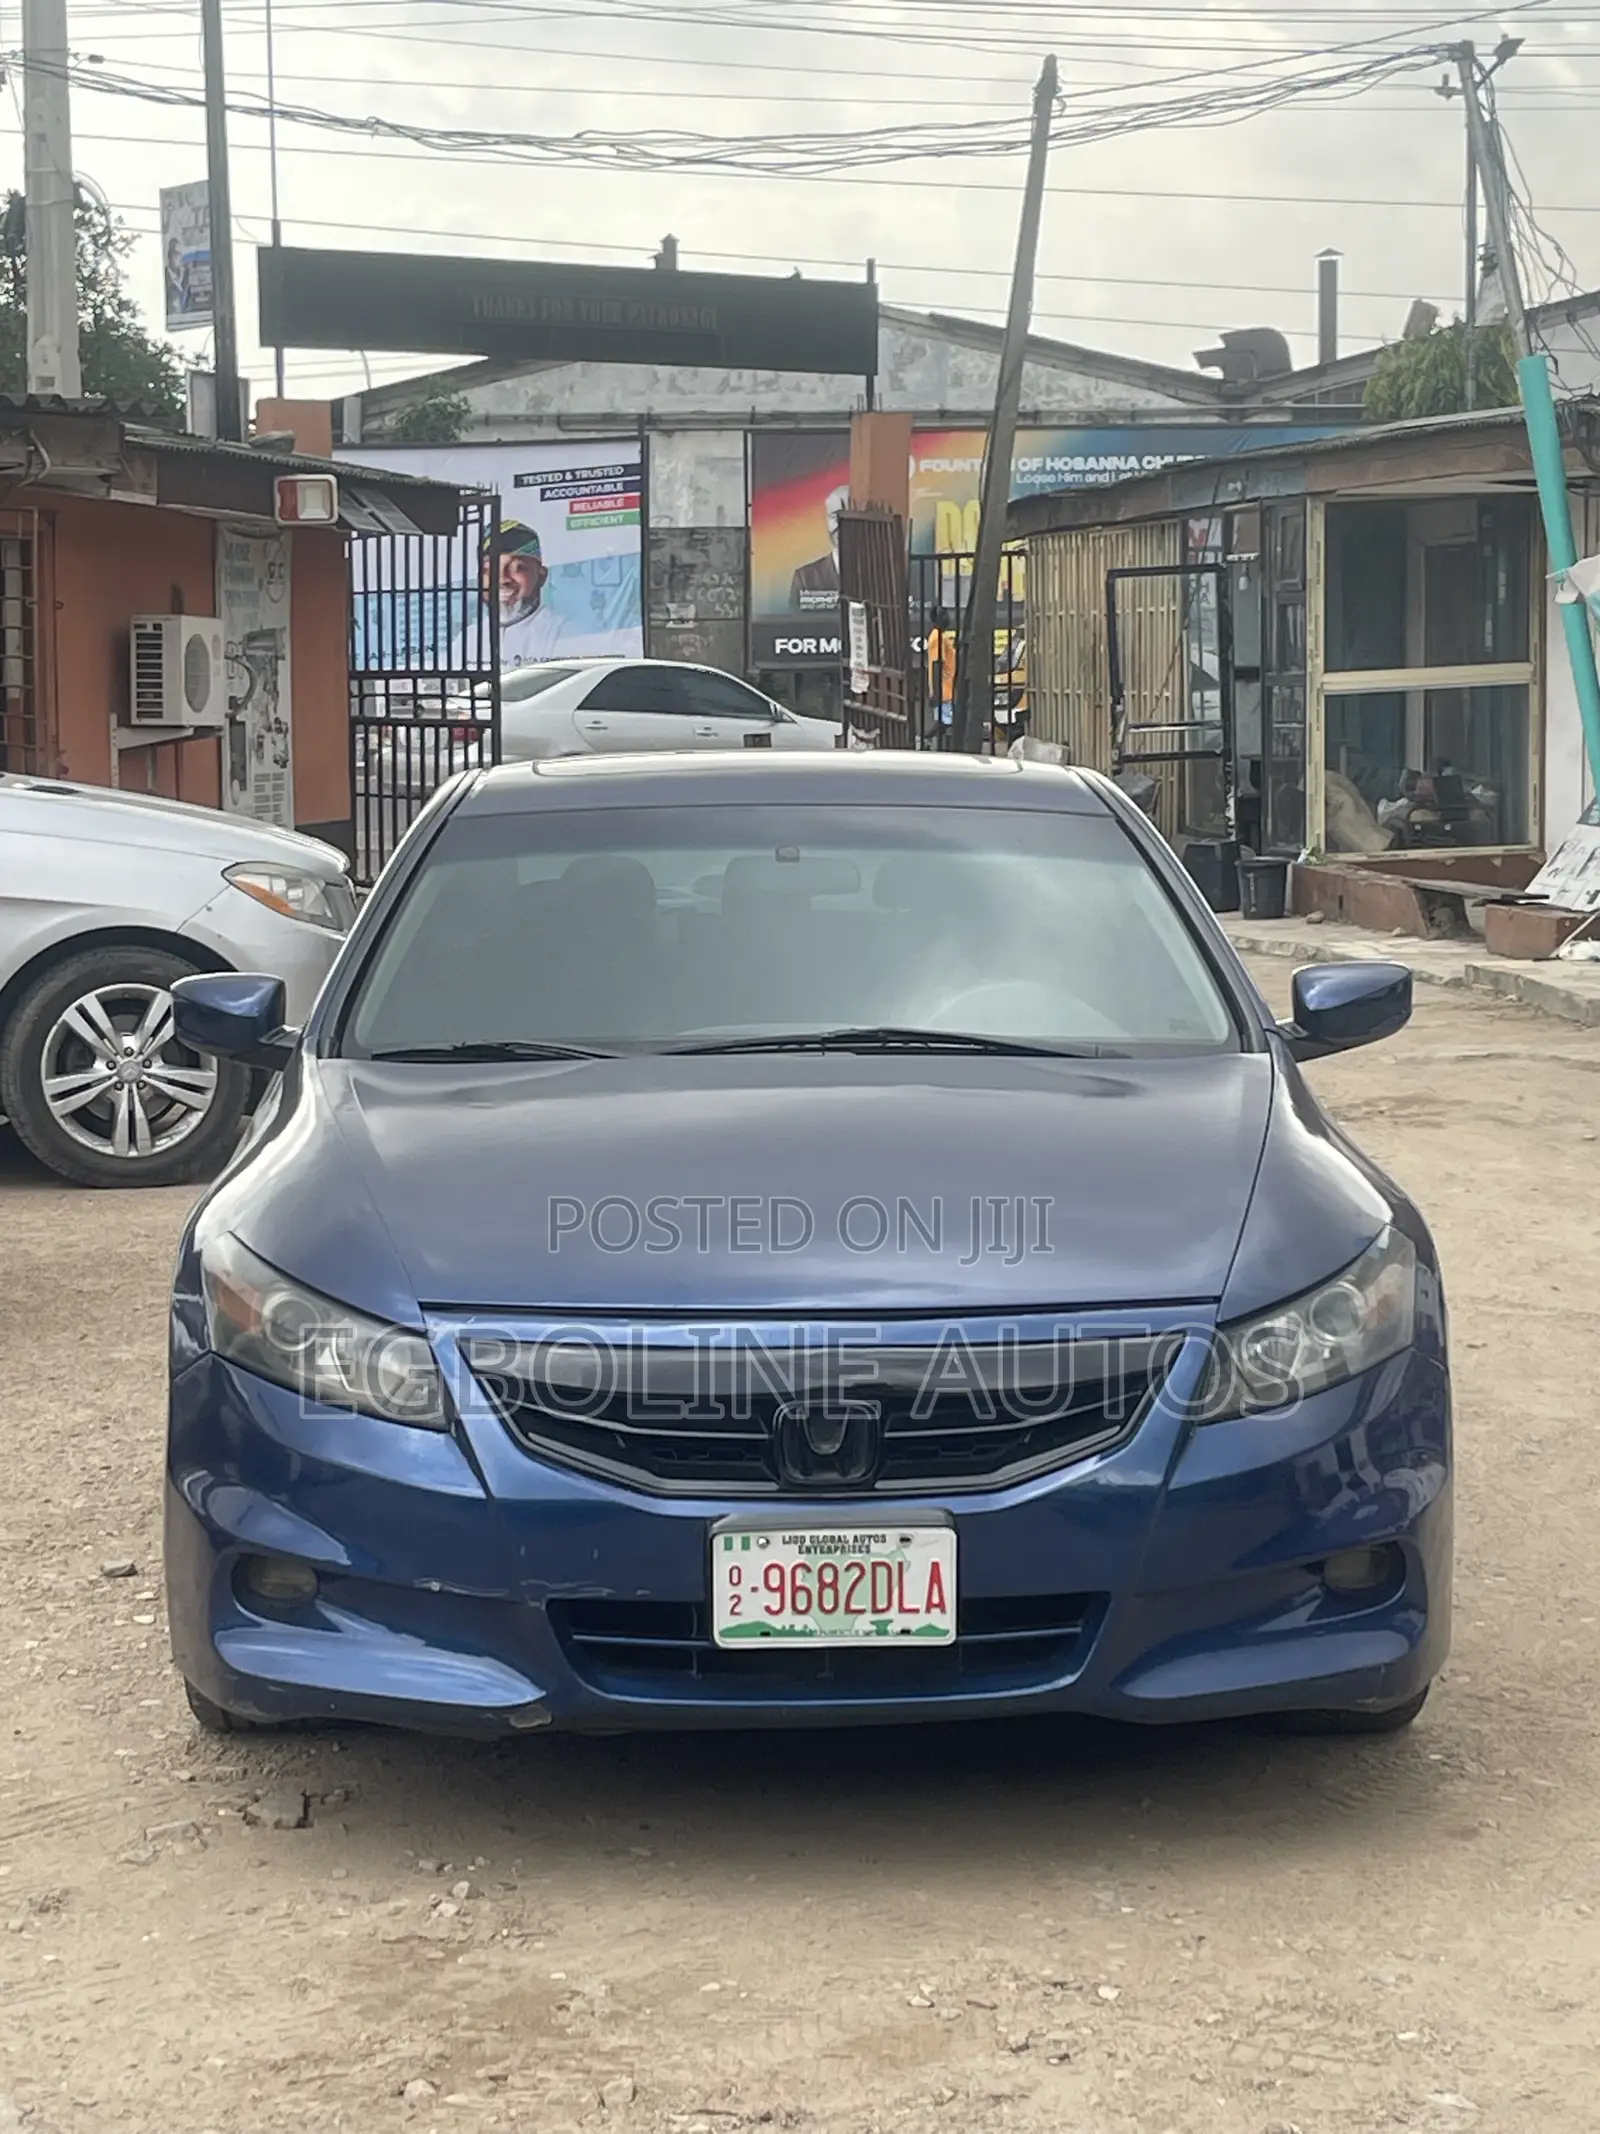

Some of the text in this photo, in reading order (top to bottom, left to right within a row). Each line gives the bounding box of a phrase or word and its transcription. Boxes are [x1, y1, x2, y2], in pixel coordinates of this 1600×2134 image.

[1017, 457, 1043, 472] OF
[1046, 455, 1139, 471] HOSANNA
[521, 473, 563, 485] TESTED
[575, 466, 624, 480] TRUSTED
[1058, 472, 1083, 483] Him
[1085, 472, 1109, 483] and
[544, 483, 624, 499] ACCOUNTABLE
[572, 499, 624, 512] RELIABLE
[775, 638, 817, 654] FOR
[809, 1535, 850, 1545] GLOBAL
[852, 1534, 887, 1544] AUTOS
[797, 1544, 872, 1555] ENTERPRISES
